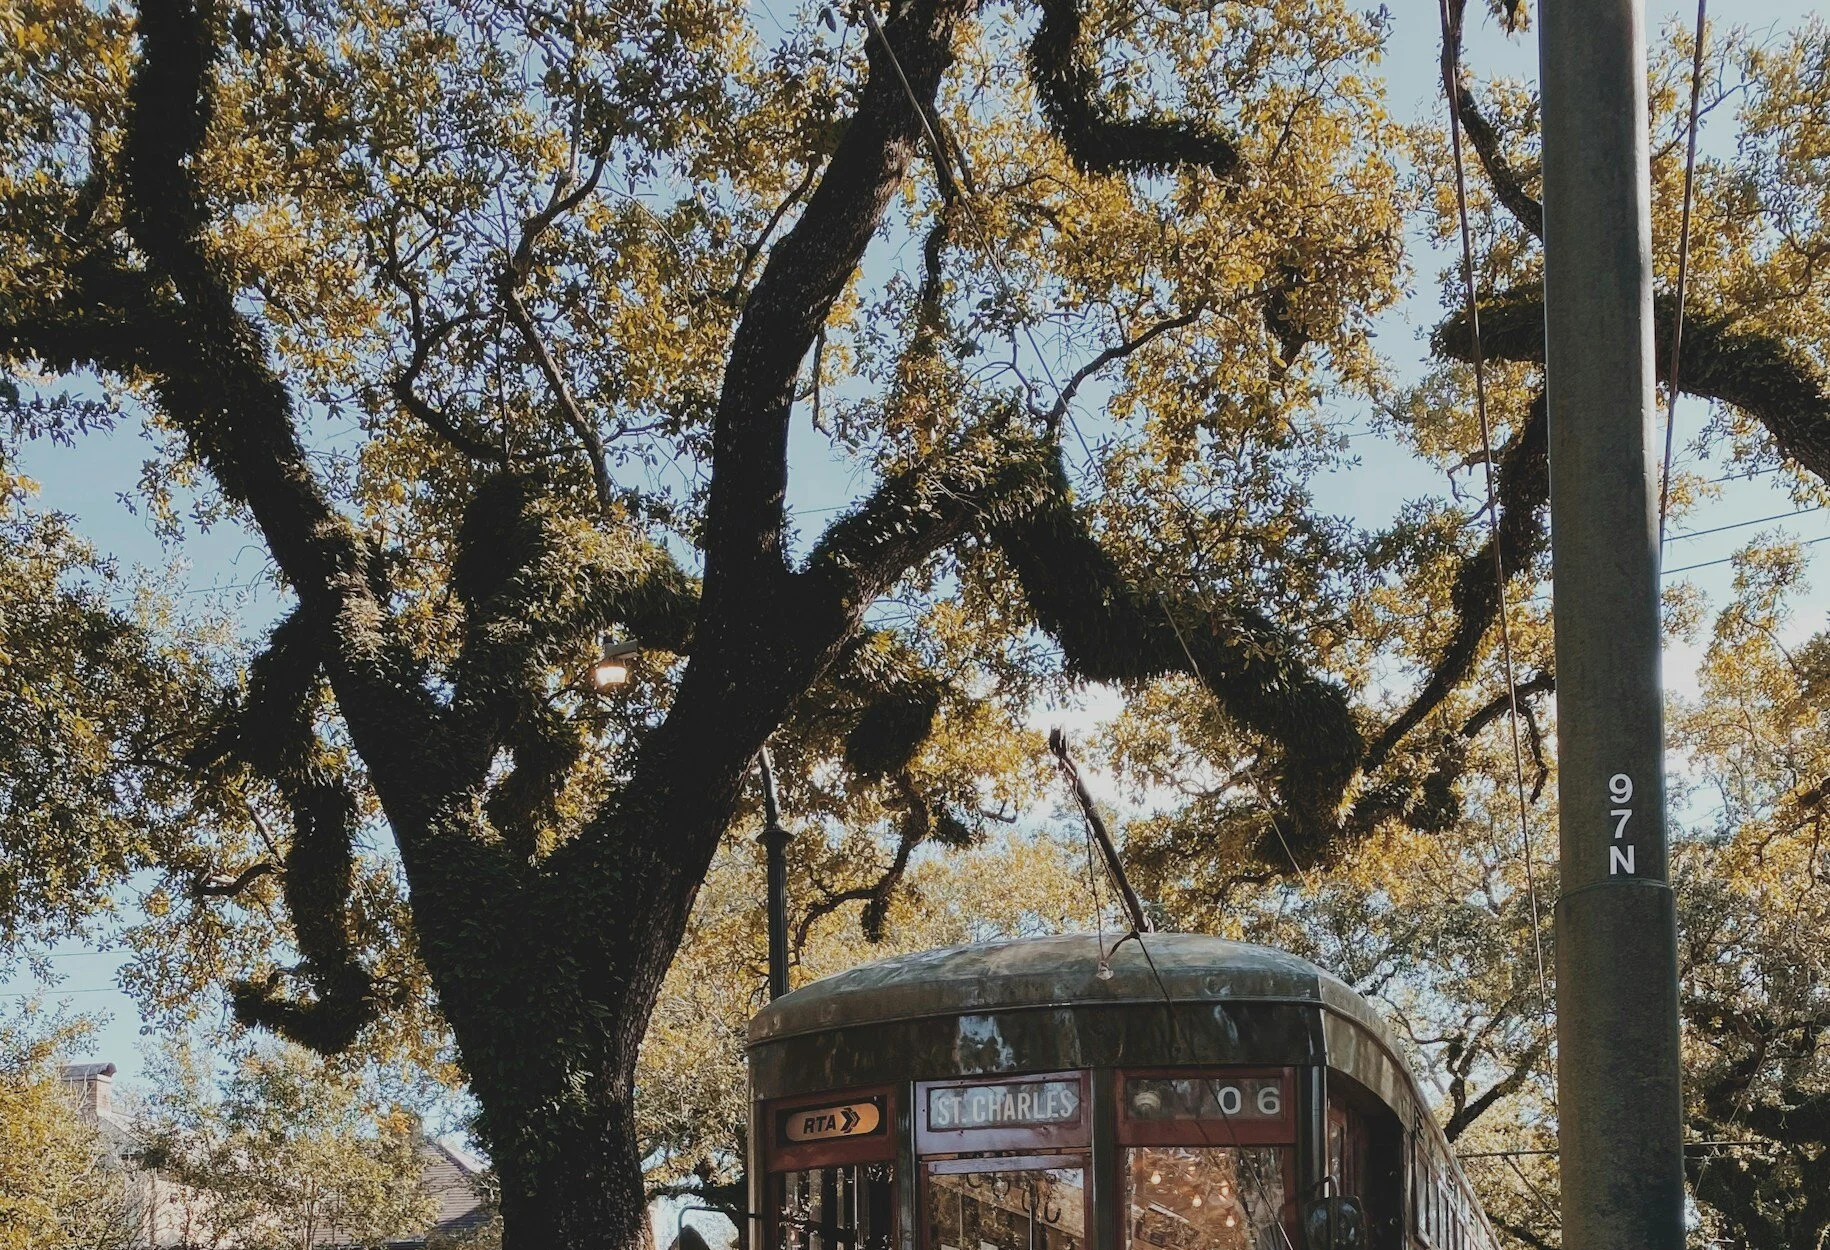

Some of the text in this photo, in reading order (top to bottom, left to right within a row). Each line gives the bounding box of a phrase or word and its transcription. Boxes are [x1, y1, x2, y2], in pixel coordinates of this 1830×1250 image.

[1608, 773, 1635, 875] 97N
[803, 1114, 837, 1135] RTA
[937, 1089, 1075, 1126] ST. CHARLES
